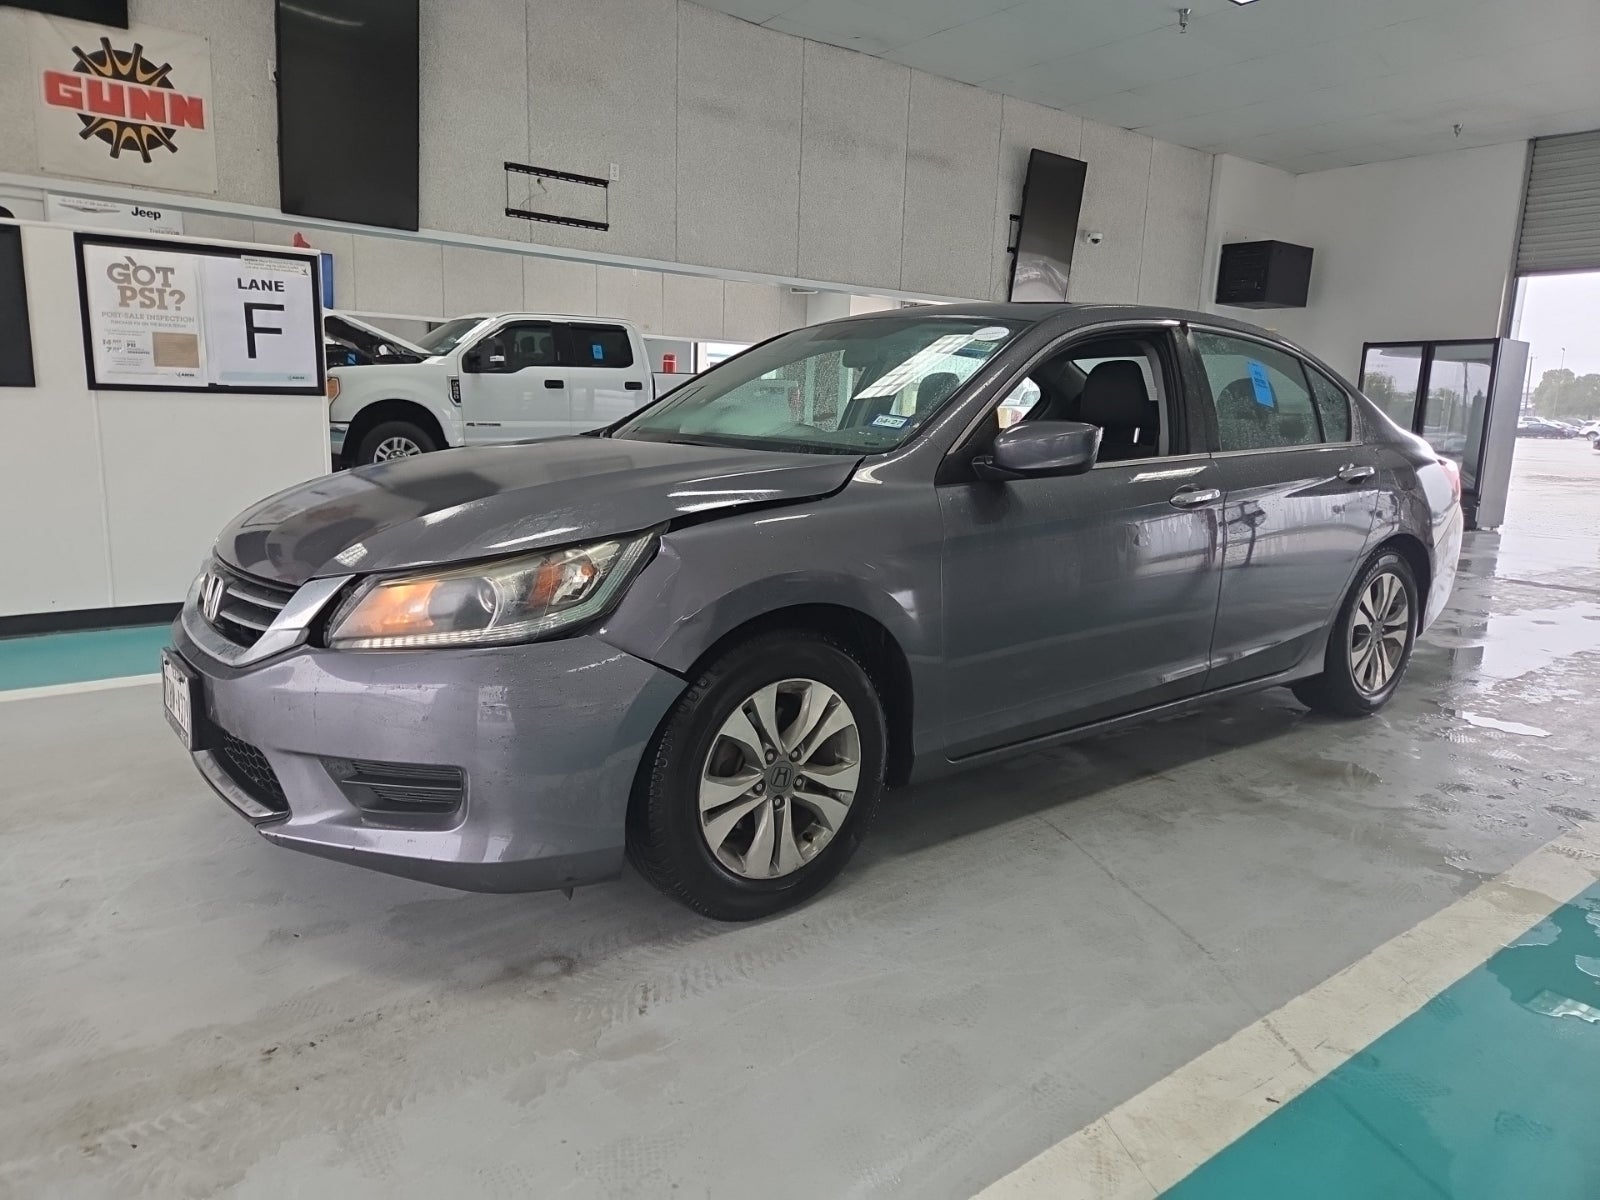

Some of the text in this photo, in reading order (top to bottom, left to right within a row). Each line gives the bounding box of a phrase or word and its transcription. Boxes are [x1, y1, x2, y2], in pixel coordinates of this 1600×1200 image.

[44, 70, 205, 130] GUNN
[131, 206, 161, 220] Jeep
[106, 261, 175, 288] GOT
[237, 277, 285, 292] LANE
[117, 285, 186, 311] PSI?
[146, 313, 195, 323] INSPECTION
[243, 301, 285, 359] F
